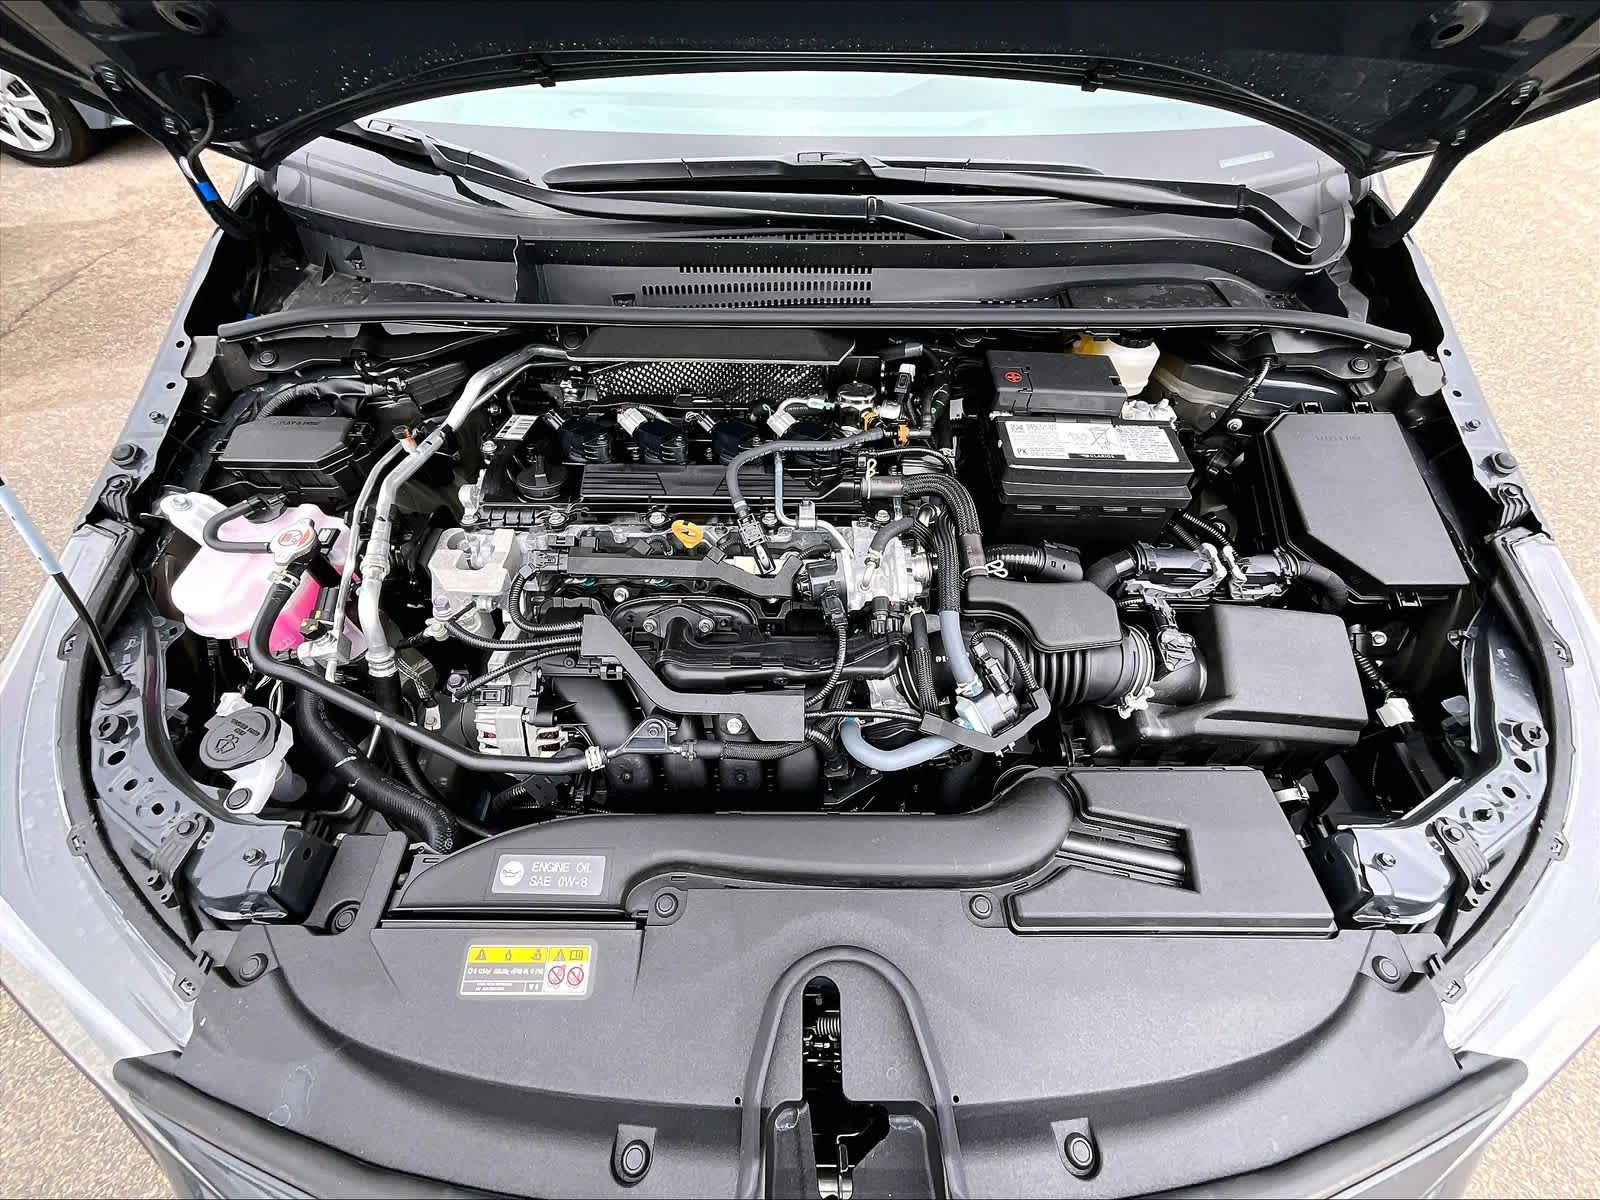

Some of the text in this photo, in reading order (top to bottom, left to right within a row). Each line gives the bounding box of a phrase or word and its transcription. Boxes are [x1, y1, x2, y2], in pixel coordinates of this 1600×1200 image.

[531, 862, 593, 873] ENGINE OIL
[529, 876, 552, 887] SAE
